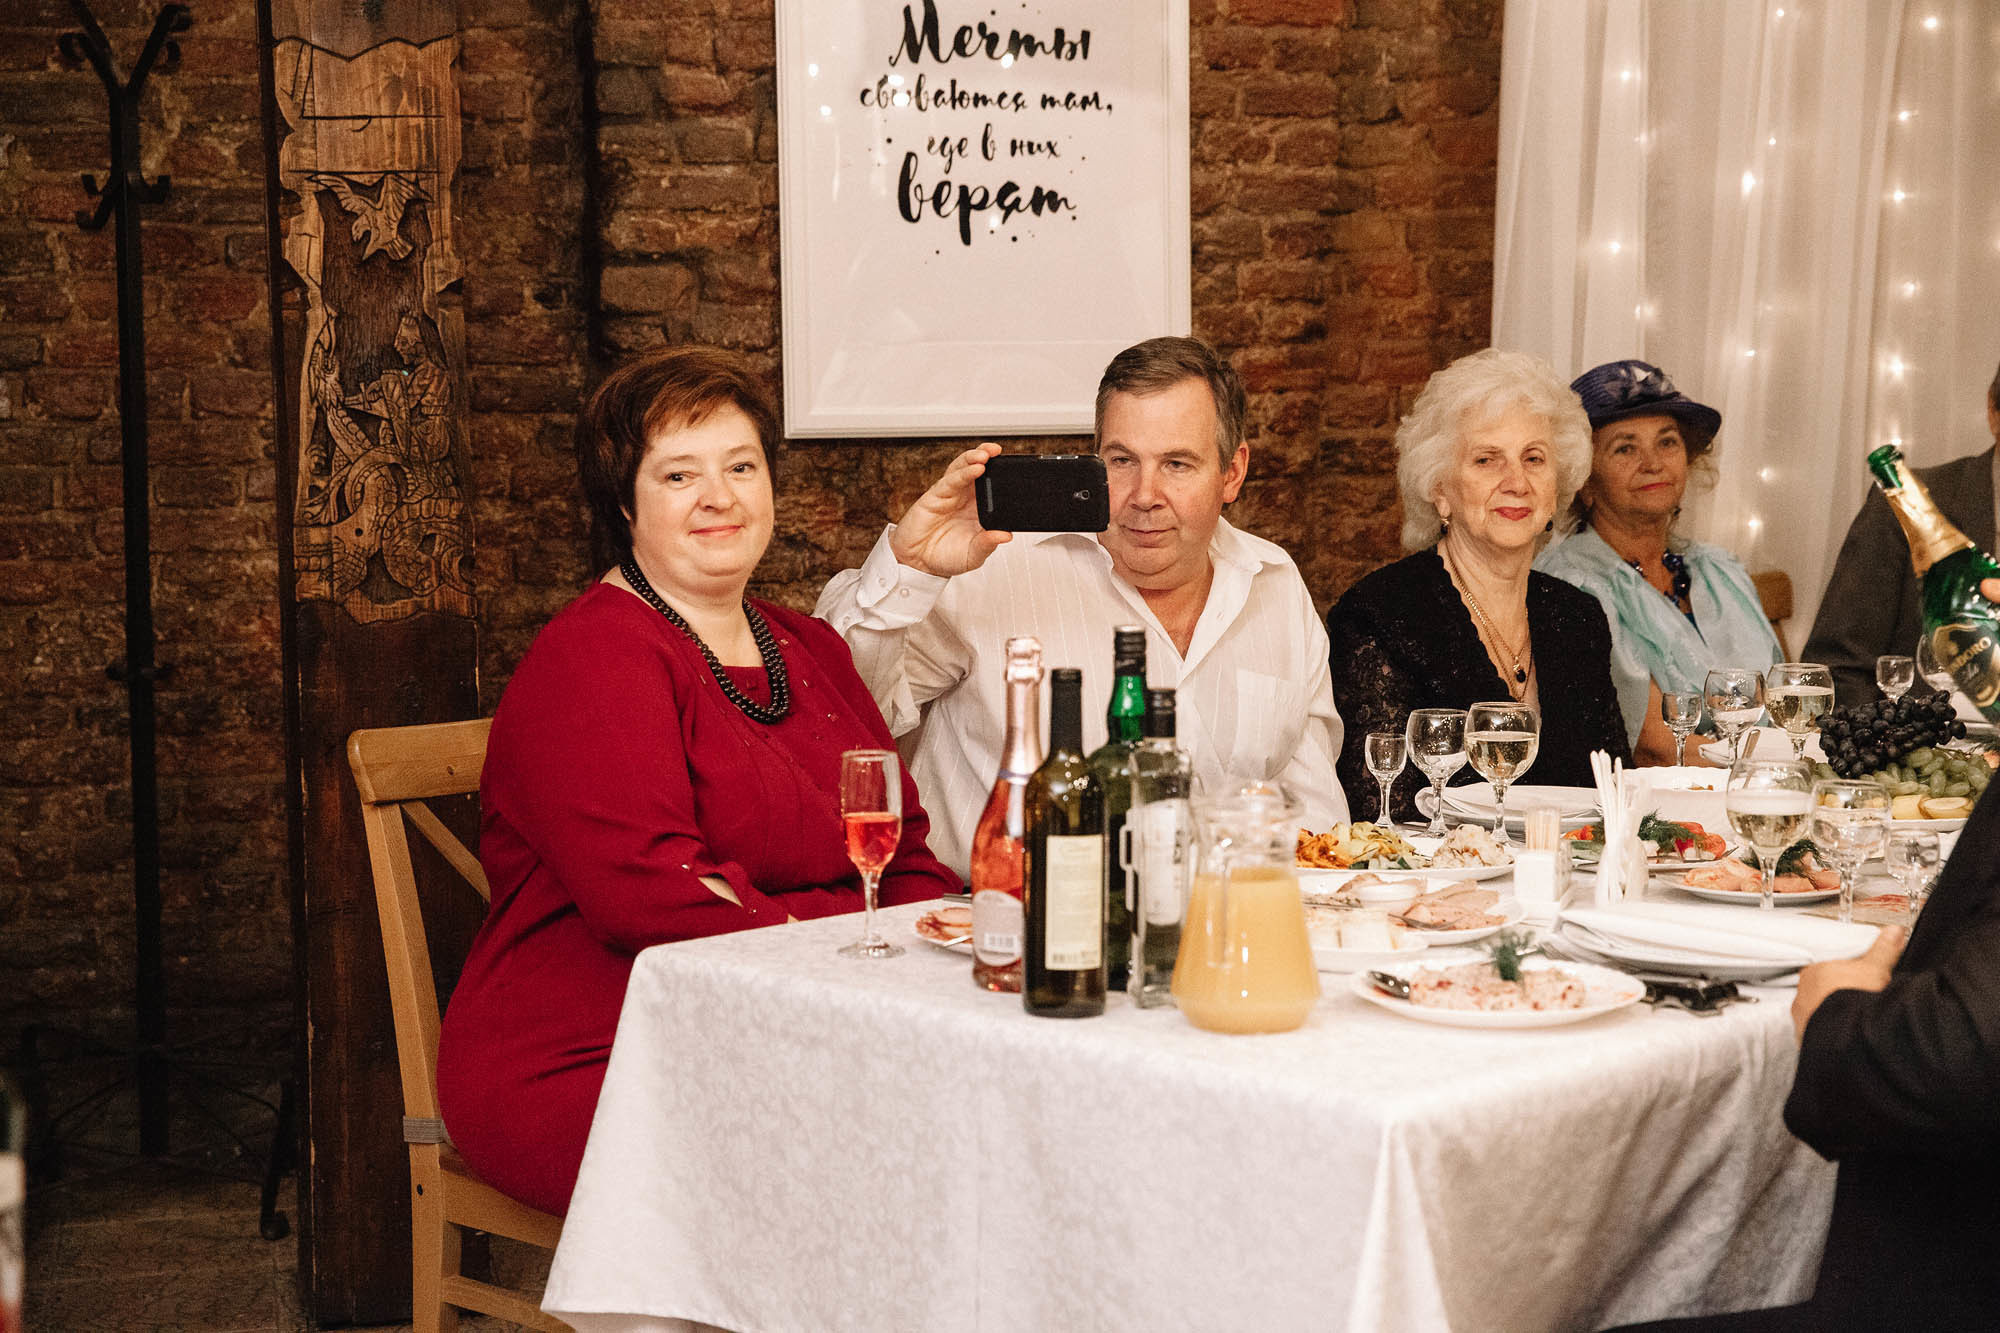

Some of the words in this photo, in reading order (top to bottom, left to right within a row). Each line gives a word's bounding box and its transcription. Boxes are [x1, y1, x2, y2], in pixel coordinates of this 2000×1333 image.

[889, 0, 1091, 67] Мечты
[1041, 91, 1113, 115] там,
[926, 136, 969, 174] где
[981, 123, 996, 161] в
[1010, 138, 1061, 158] них
[898, 151, 1077, 246] верят
